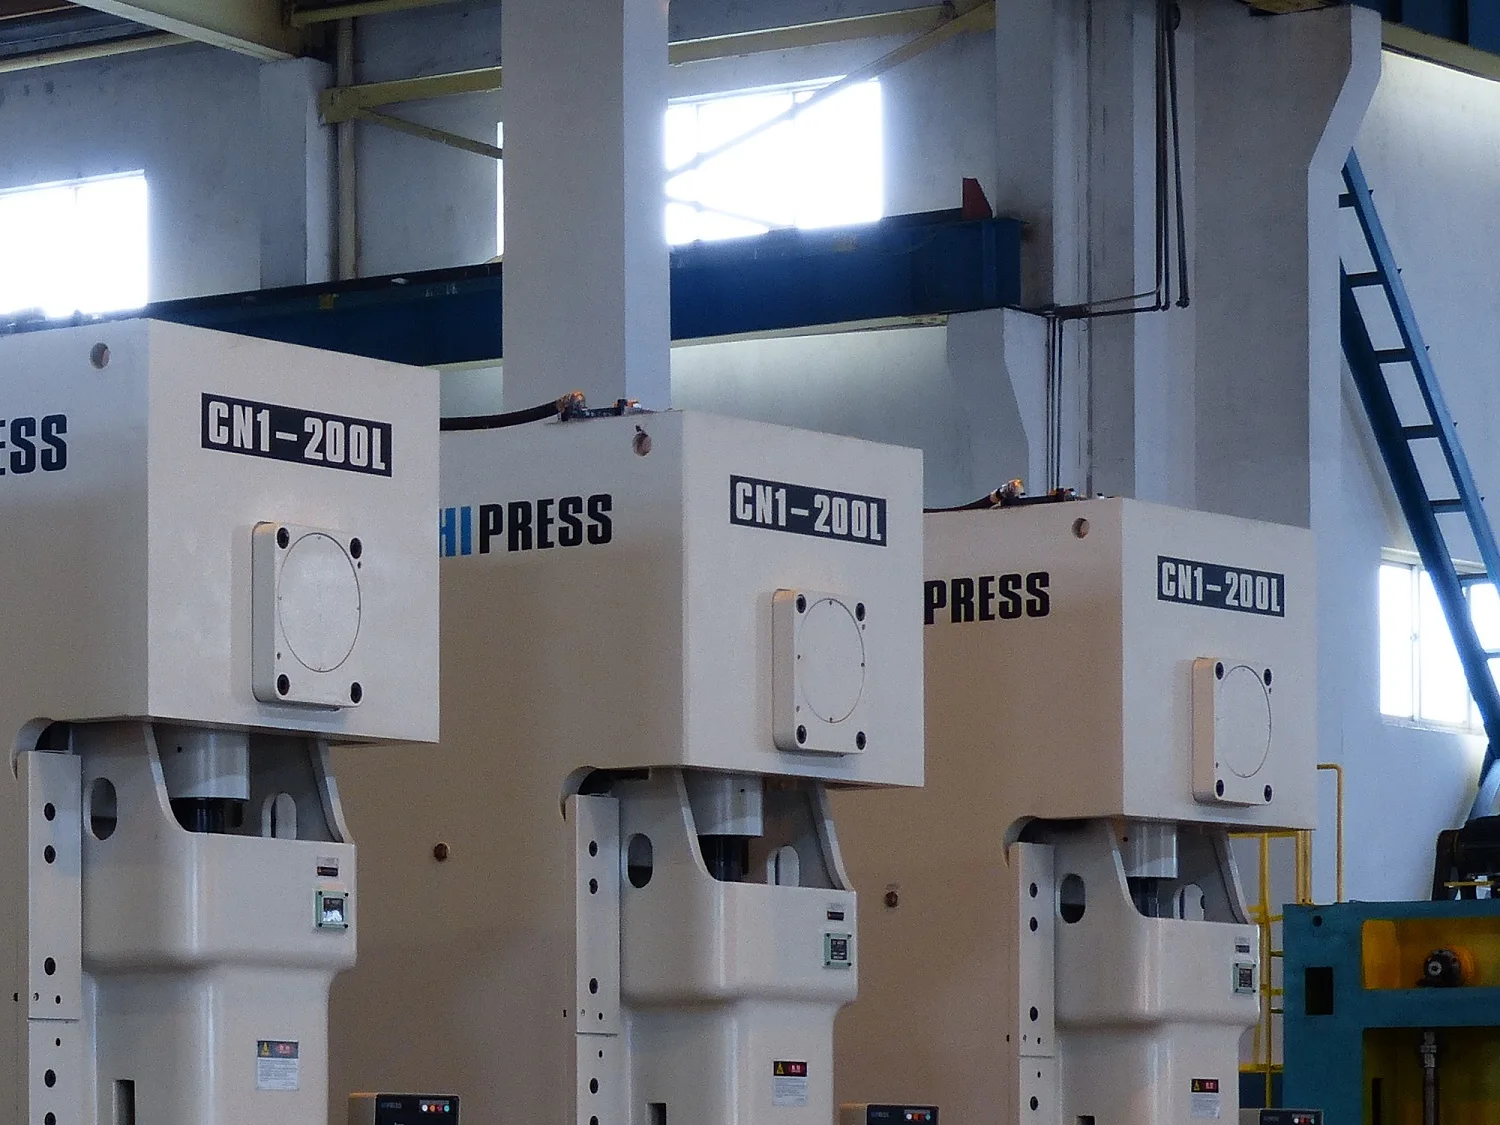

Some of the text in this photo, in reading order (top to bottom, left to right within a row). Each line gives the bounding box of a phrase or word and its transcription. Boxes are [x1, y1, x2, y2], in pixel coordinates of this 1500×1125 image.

[208, 400, 387, 471] CN1-200L
[734, 481, 882, 542] CN1-200L
[1161, 561, 1281, 614] CN1-200L
